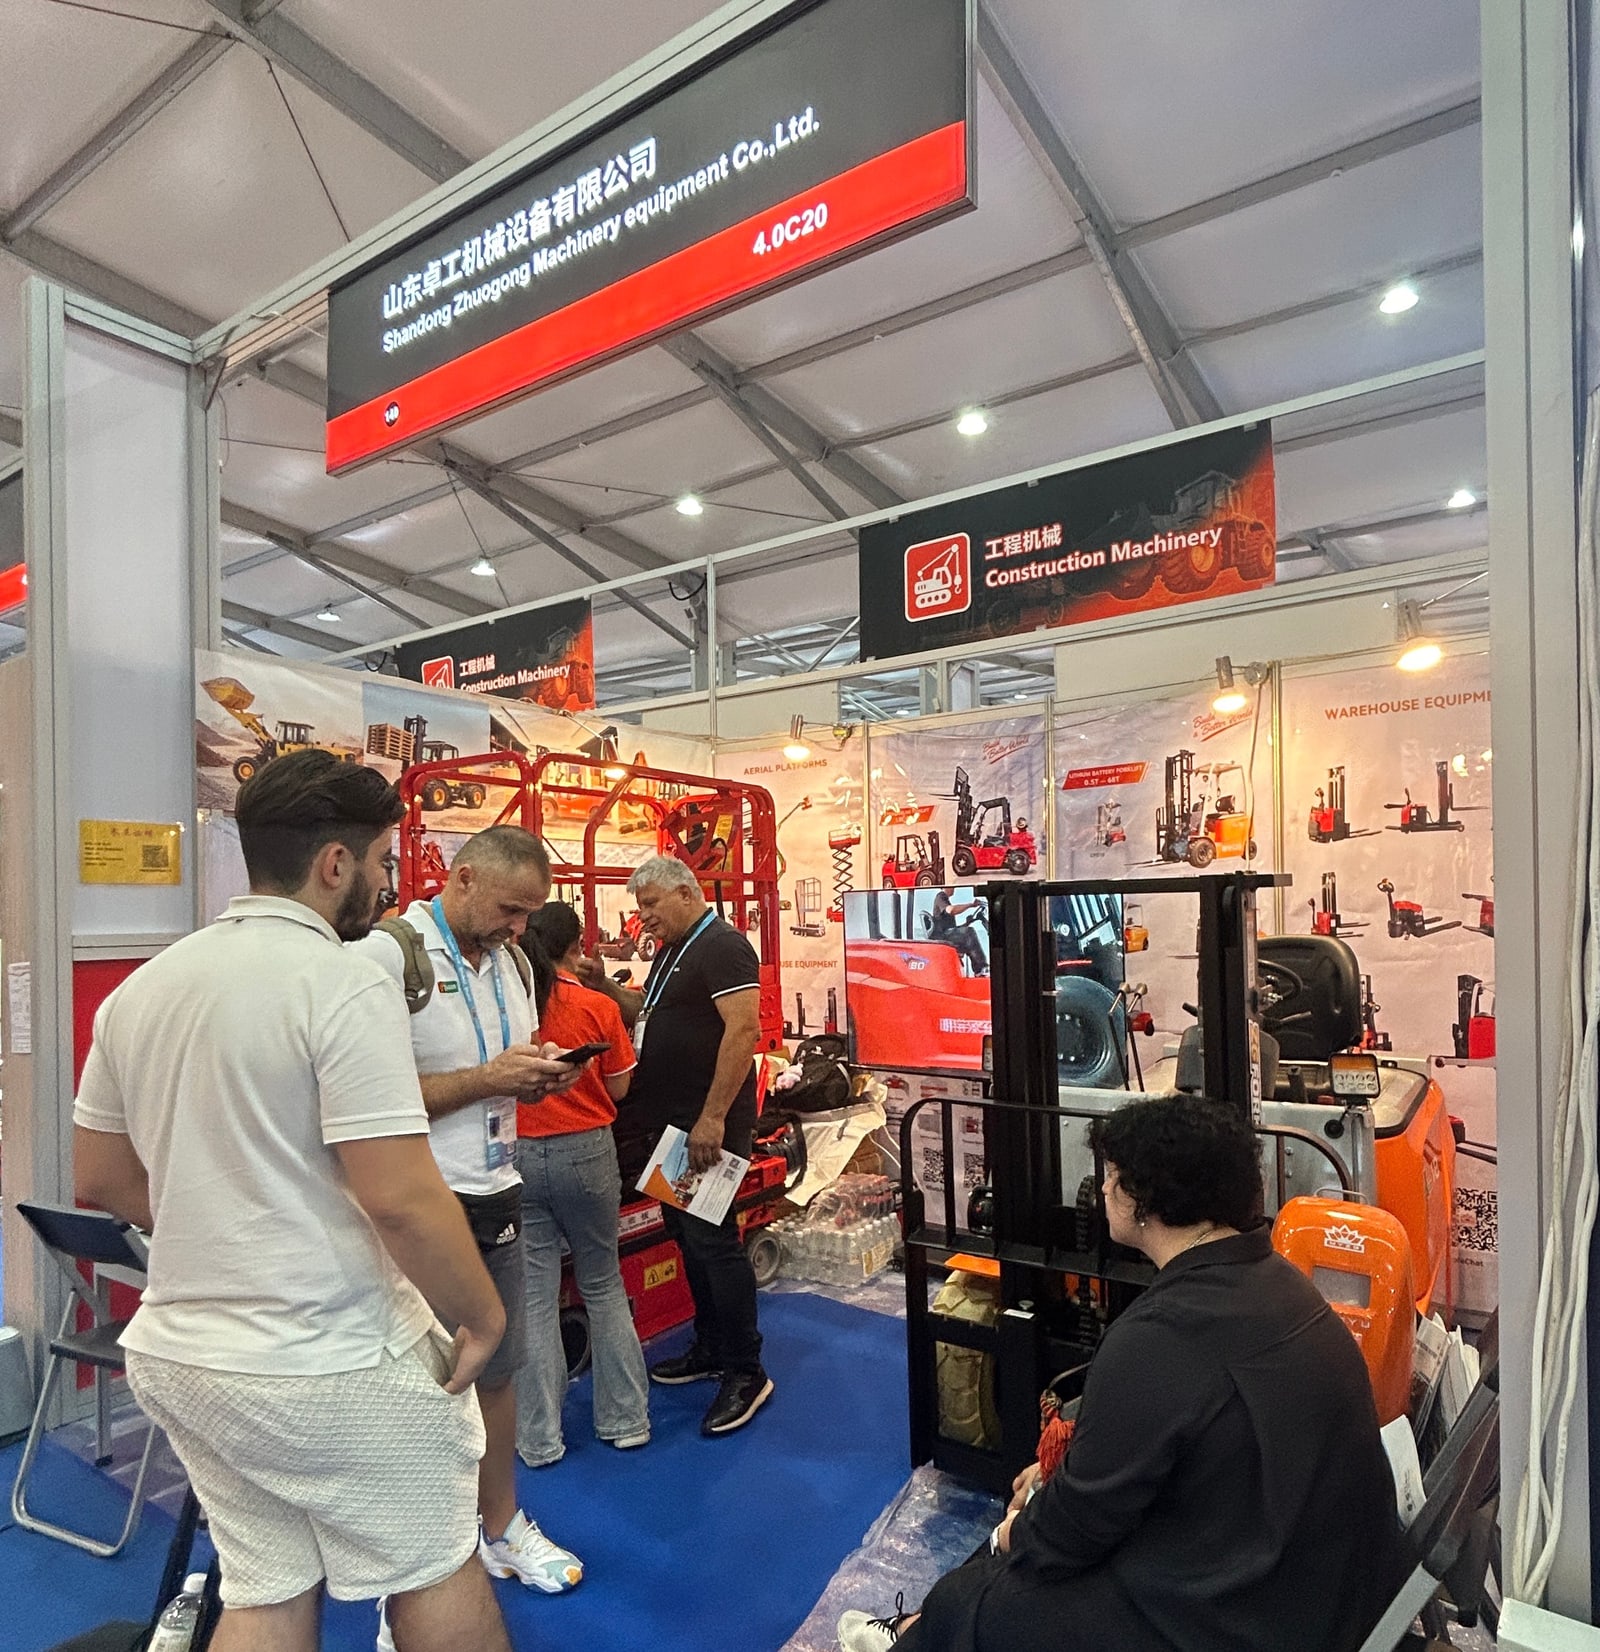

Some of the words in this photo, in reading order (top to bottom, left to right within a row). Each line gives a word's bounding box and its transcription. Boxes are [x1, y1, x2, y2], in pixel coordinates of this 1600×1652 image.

[383, 137, 656, 319] 山东卓工机械设备有限公司
[383, 304, 452, 353] Shandong
[453, 262, 531, 316] Zhuogong
[533, 213, 621, 275] Machinery
[624, 153, 728, 225] equipment
[732, 106, 820, 171] Co.,Ltd.
[752, 203, 828, 255] 4.0C20
[985, 524, 1062, 560] 工程机械
[986, 551, 1105, 587] Construction
[1111, 528, 1222, 563] Machinery
[459, 654, 496, 677] 工程机械
[517, 665, 570, 684] Machinery
[1325, 699, 1419, 720] WAREHOUSE
[744, 765, 773, 775] AERIAL
[776, 759, 827, 772] PLATFORMS
[1092, 768, 1115, 777] BATTERY
[1116, 765, 1143, 773] FORKLIFT
[795, 960, 838, 969] EQUIPMENT
